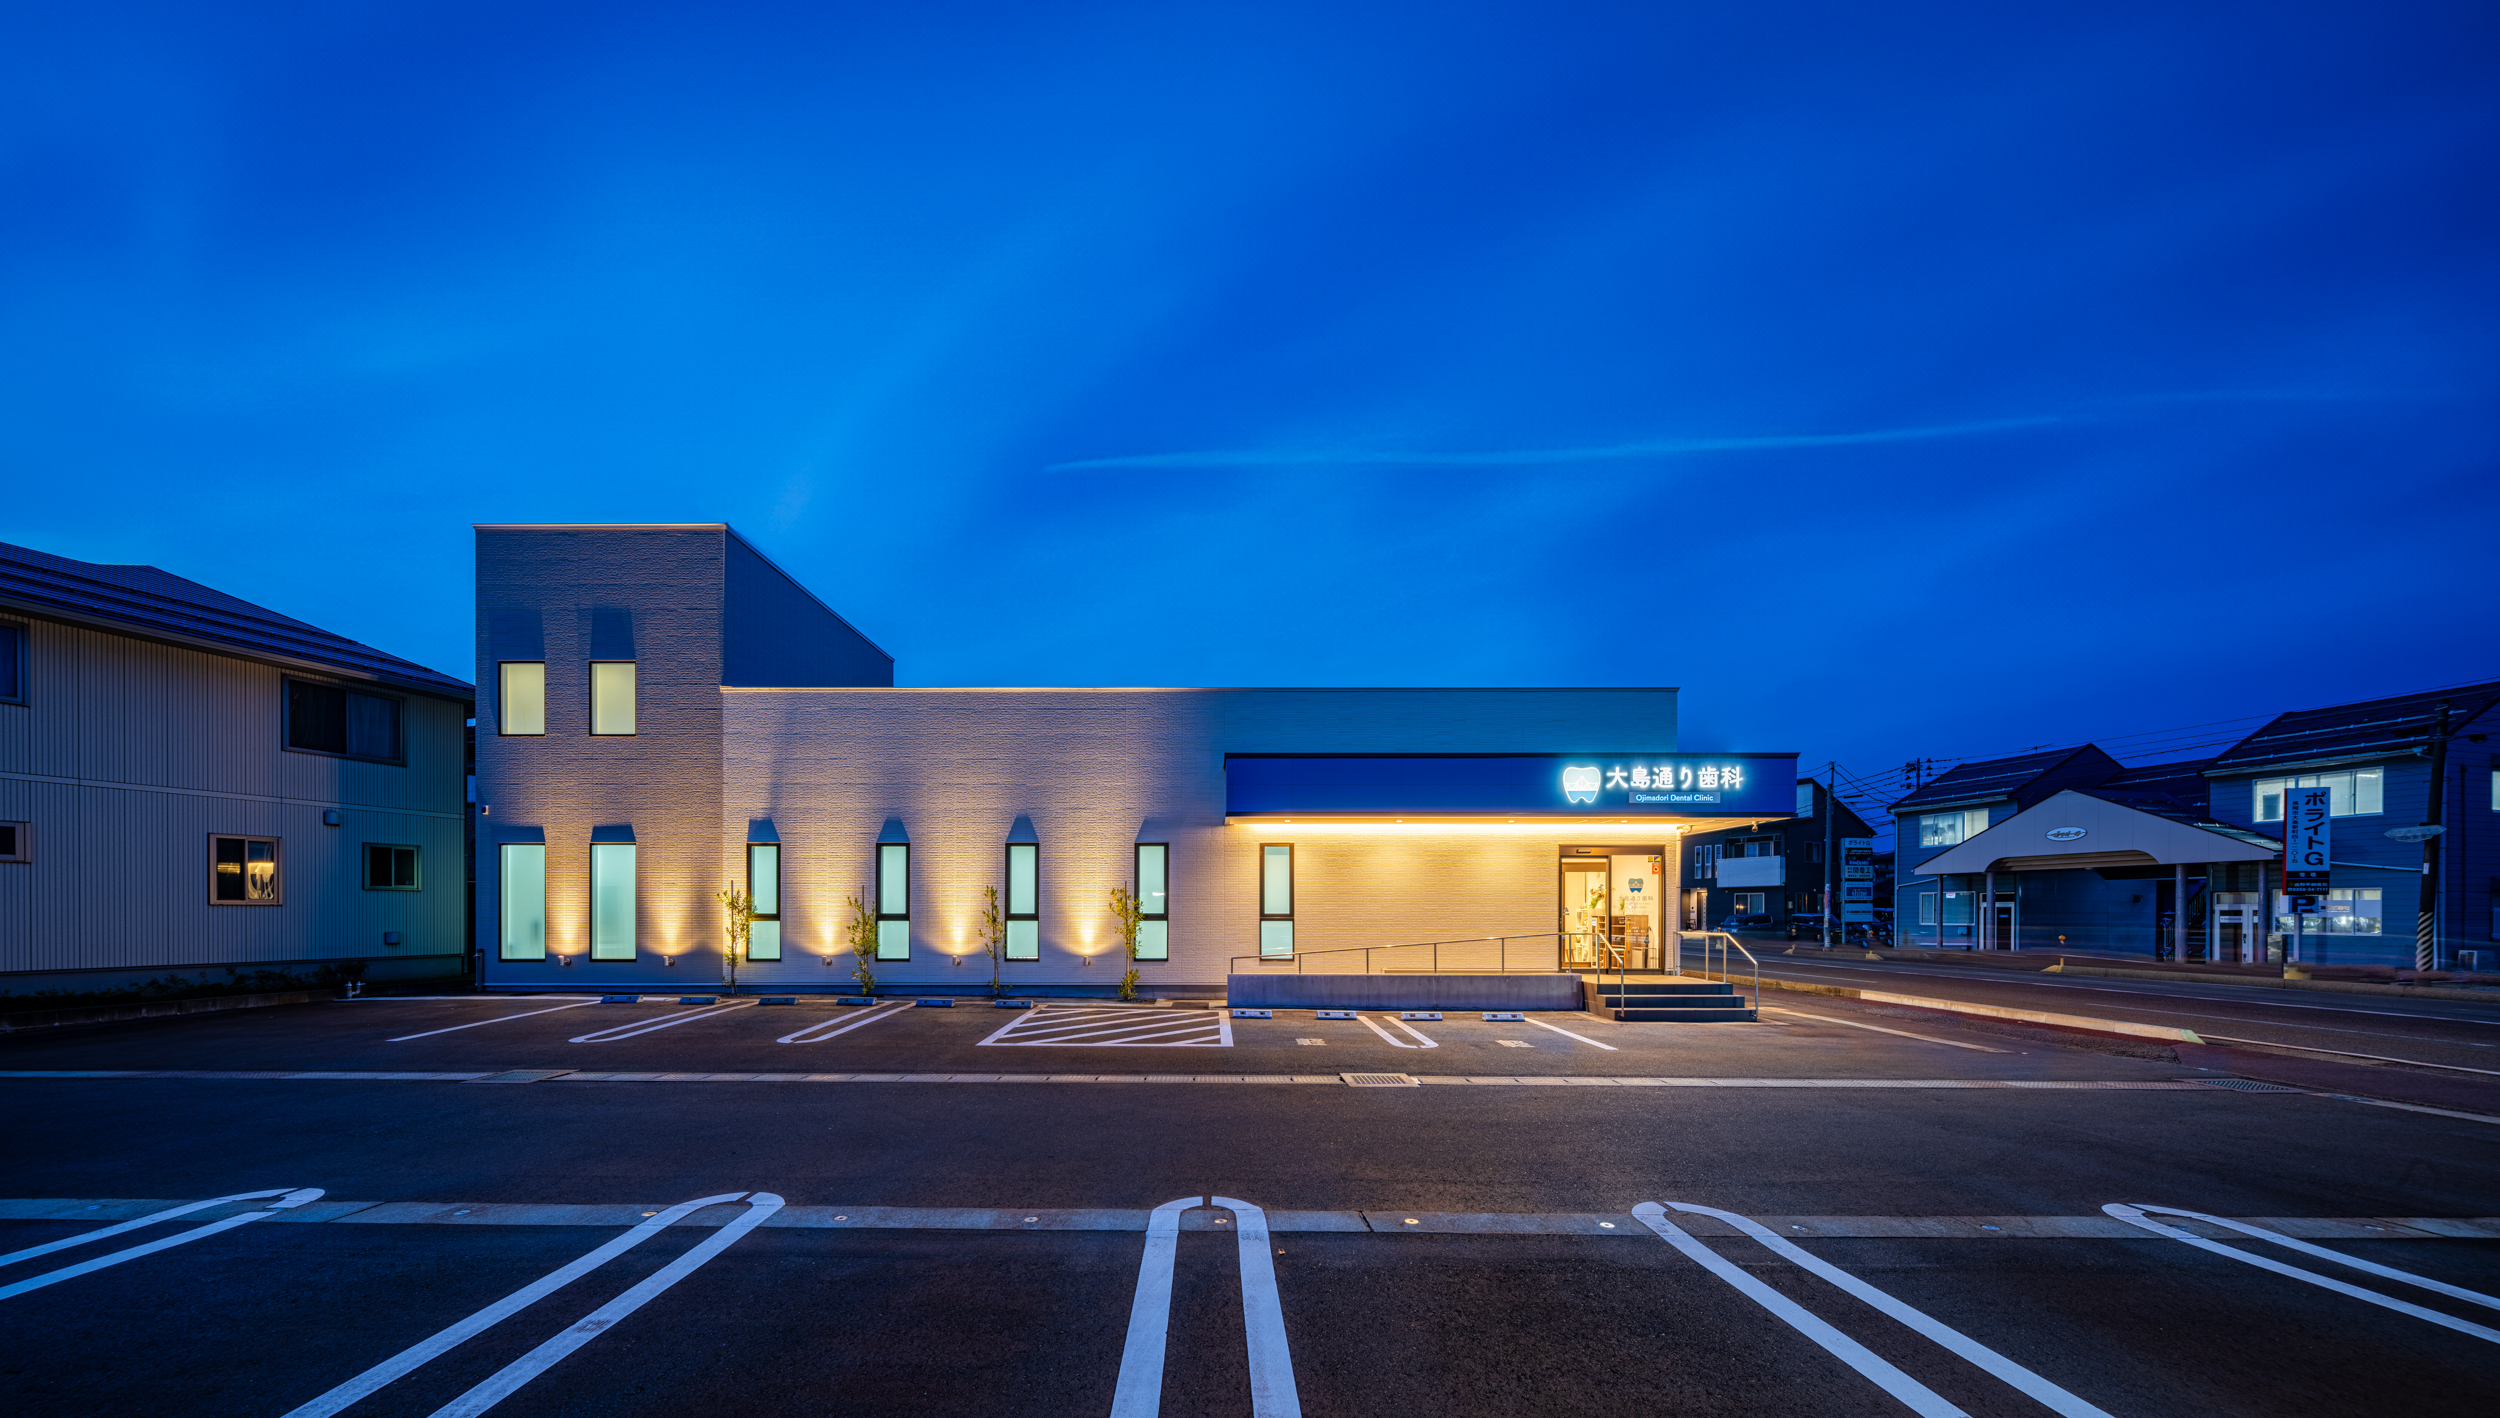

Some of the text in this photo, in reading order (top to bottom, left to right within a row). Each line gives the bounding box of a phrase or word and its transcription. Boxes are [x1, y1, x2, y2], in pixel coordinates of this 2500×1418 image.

[1606, 766, 1743, 789] 大島通り歯科
[1635, 794, 1714, 803] Ojimadori Dental Clinic
[2304, 791, 2327, 866] ポライトG
